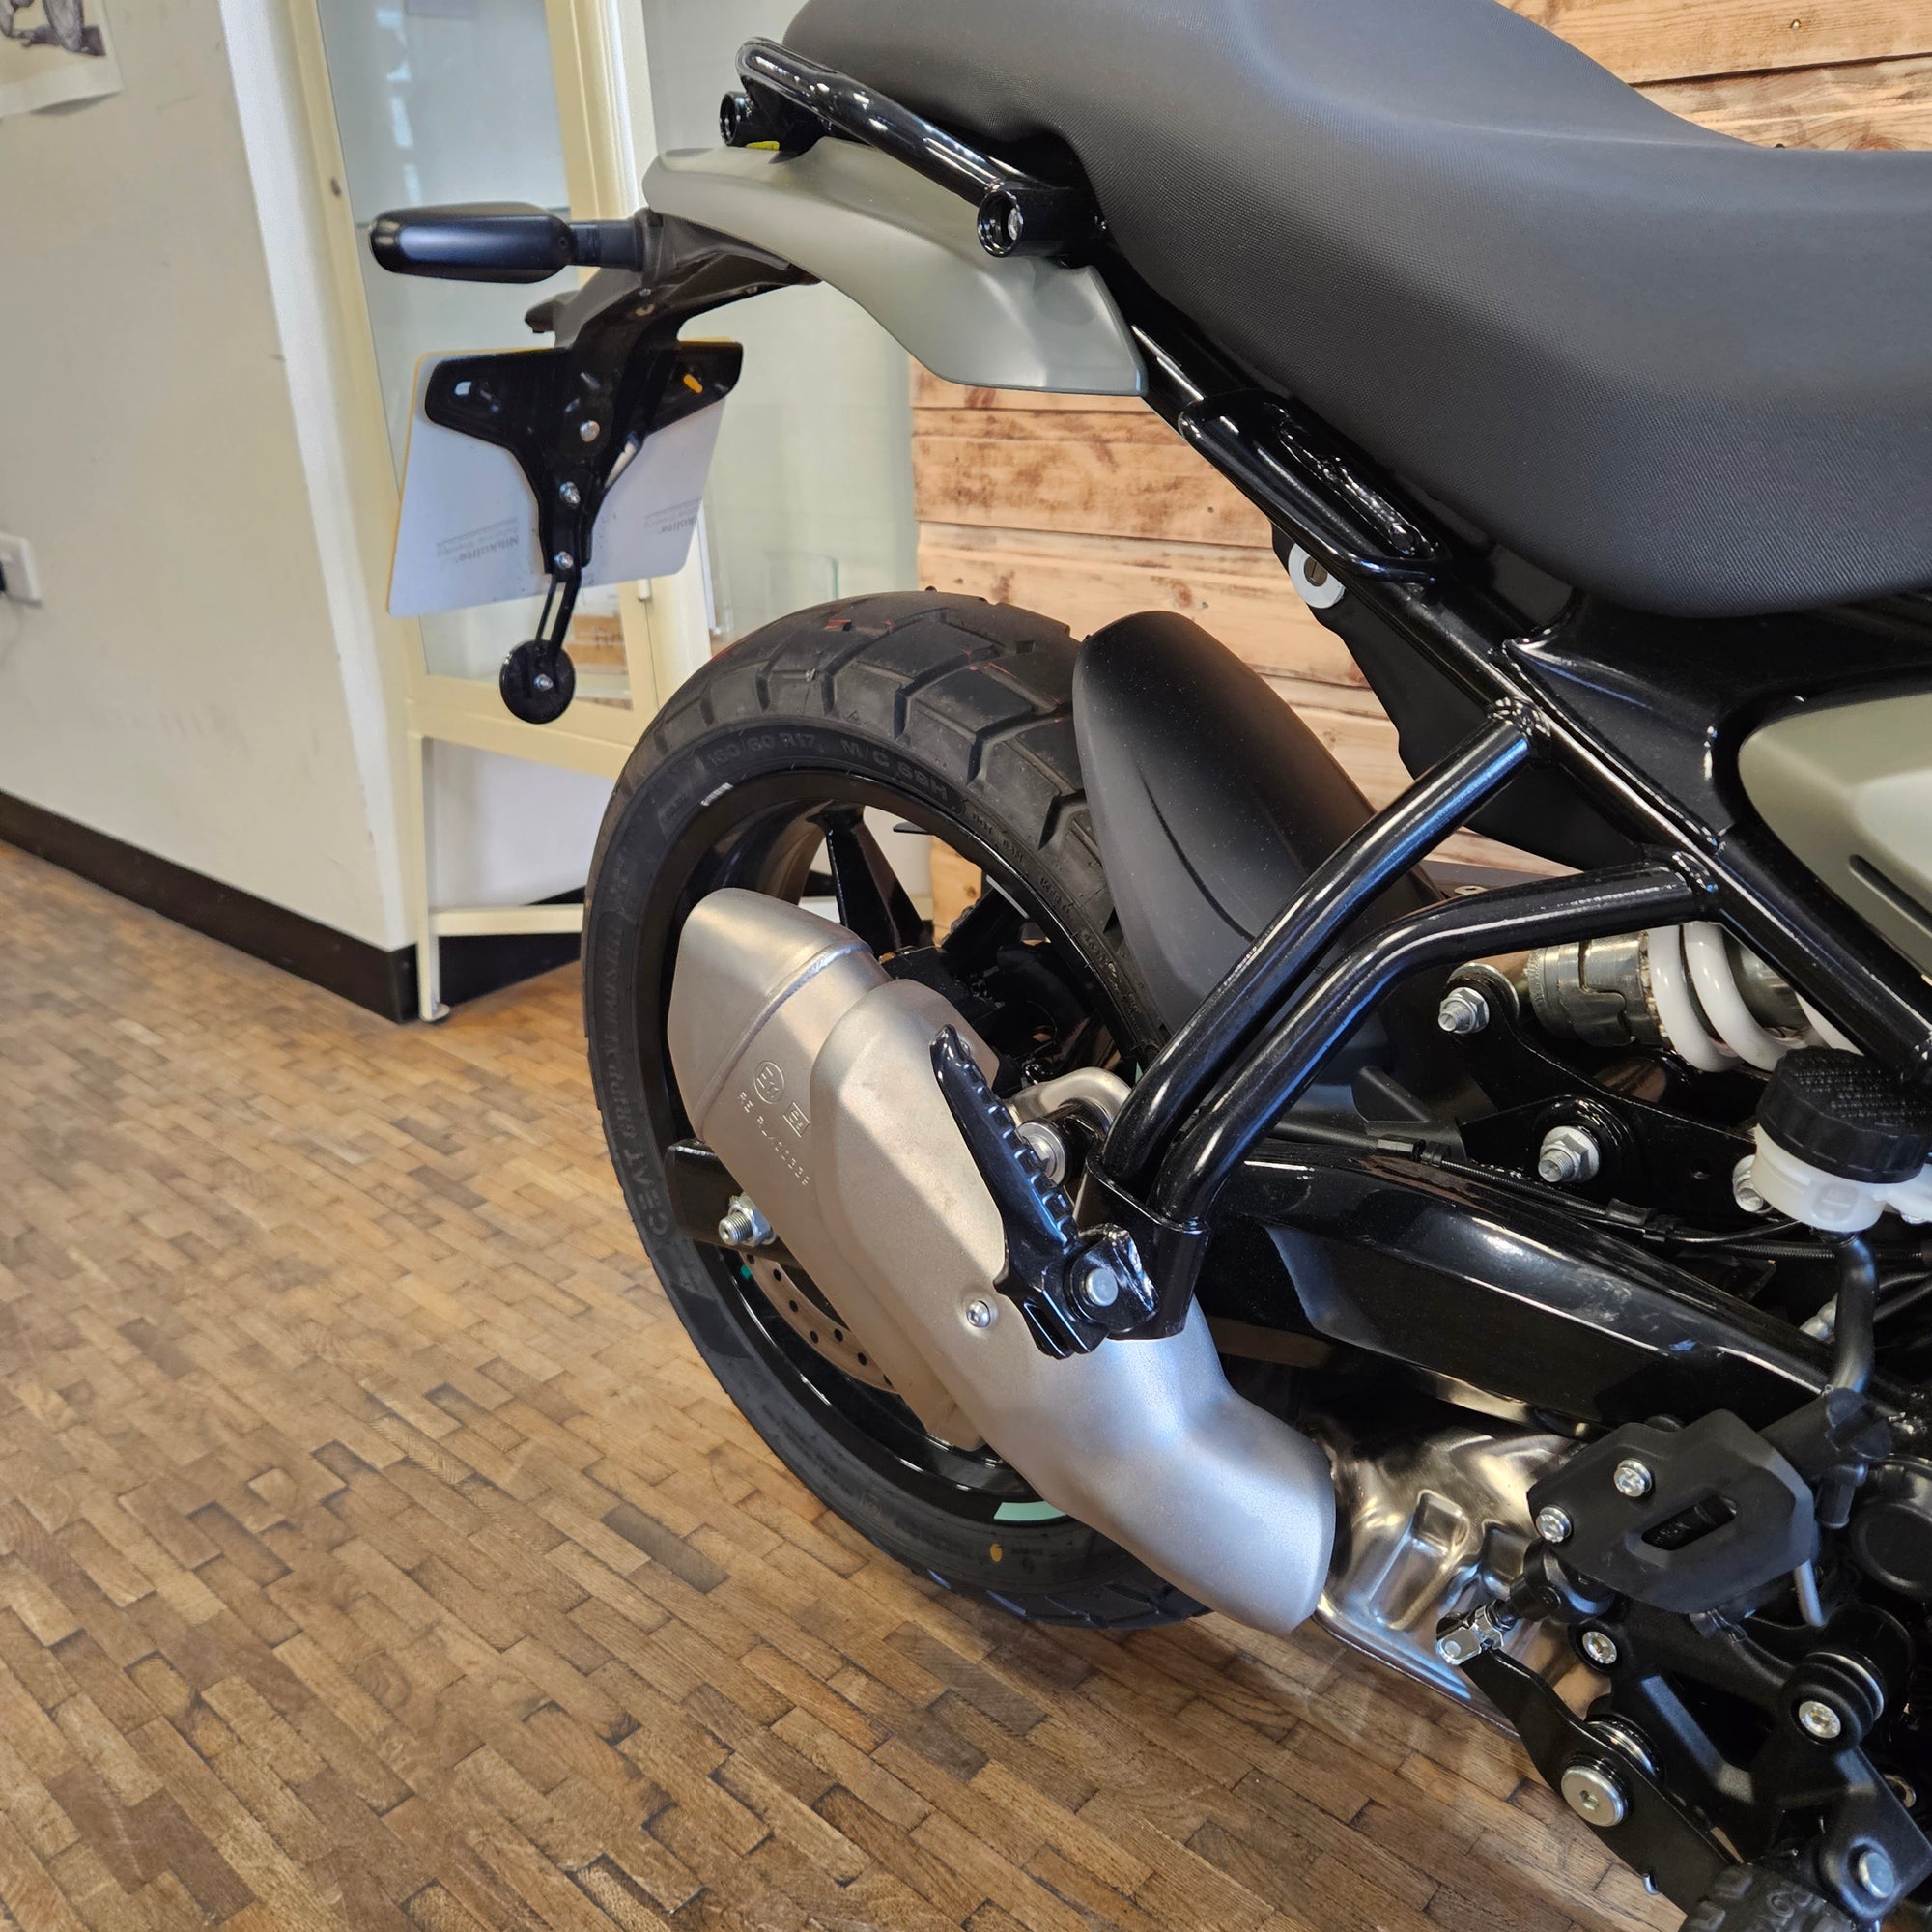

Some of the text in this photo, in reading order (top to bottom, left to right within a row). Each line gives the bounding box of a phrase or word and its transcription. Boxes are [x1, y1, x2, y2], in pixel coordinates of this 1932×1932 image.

[840, 738, 890, 769] M/C
[608, 1064, 638, 1139] GRIPP
[622, 1147, 670, 1236] CEAT
